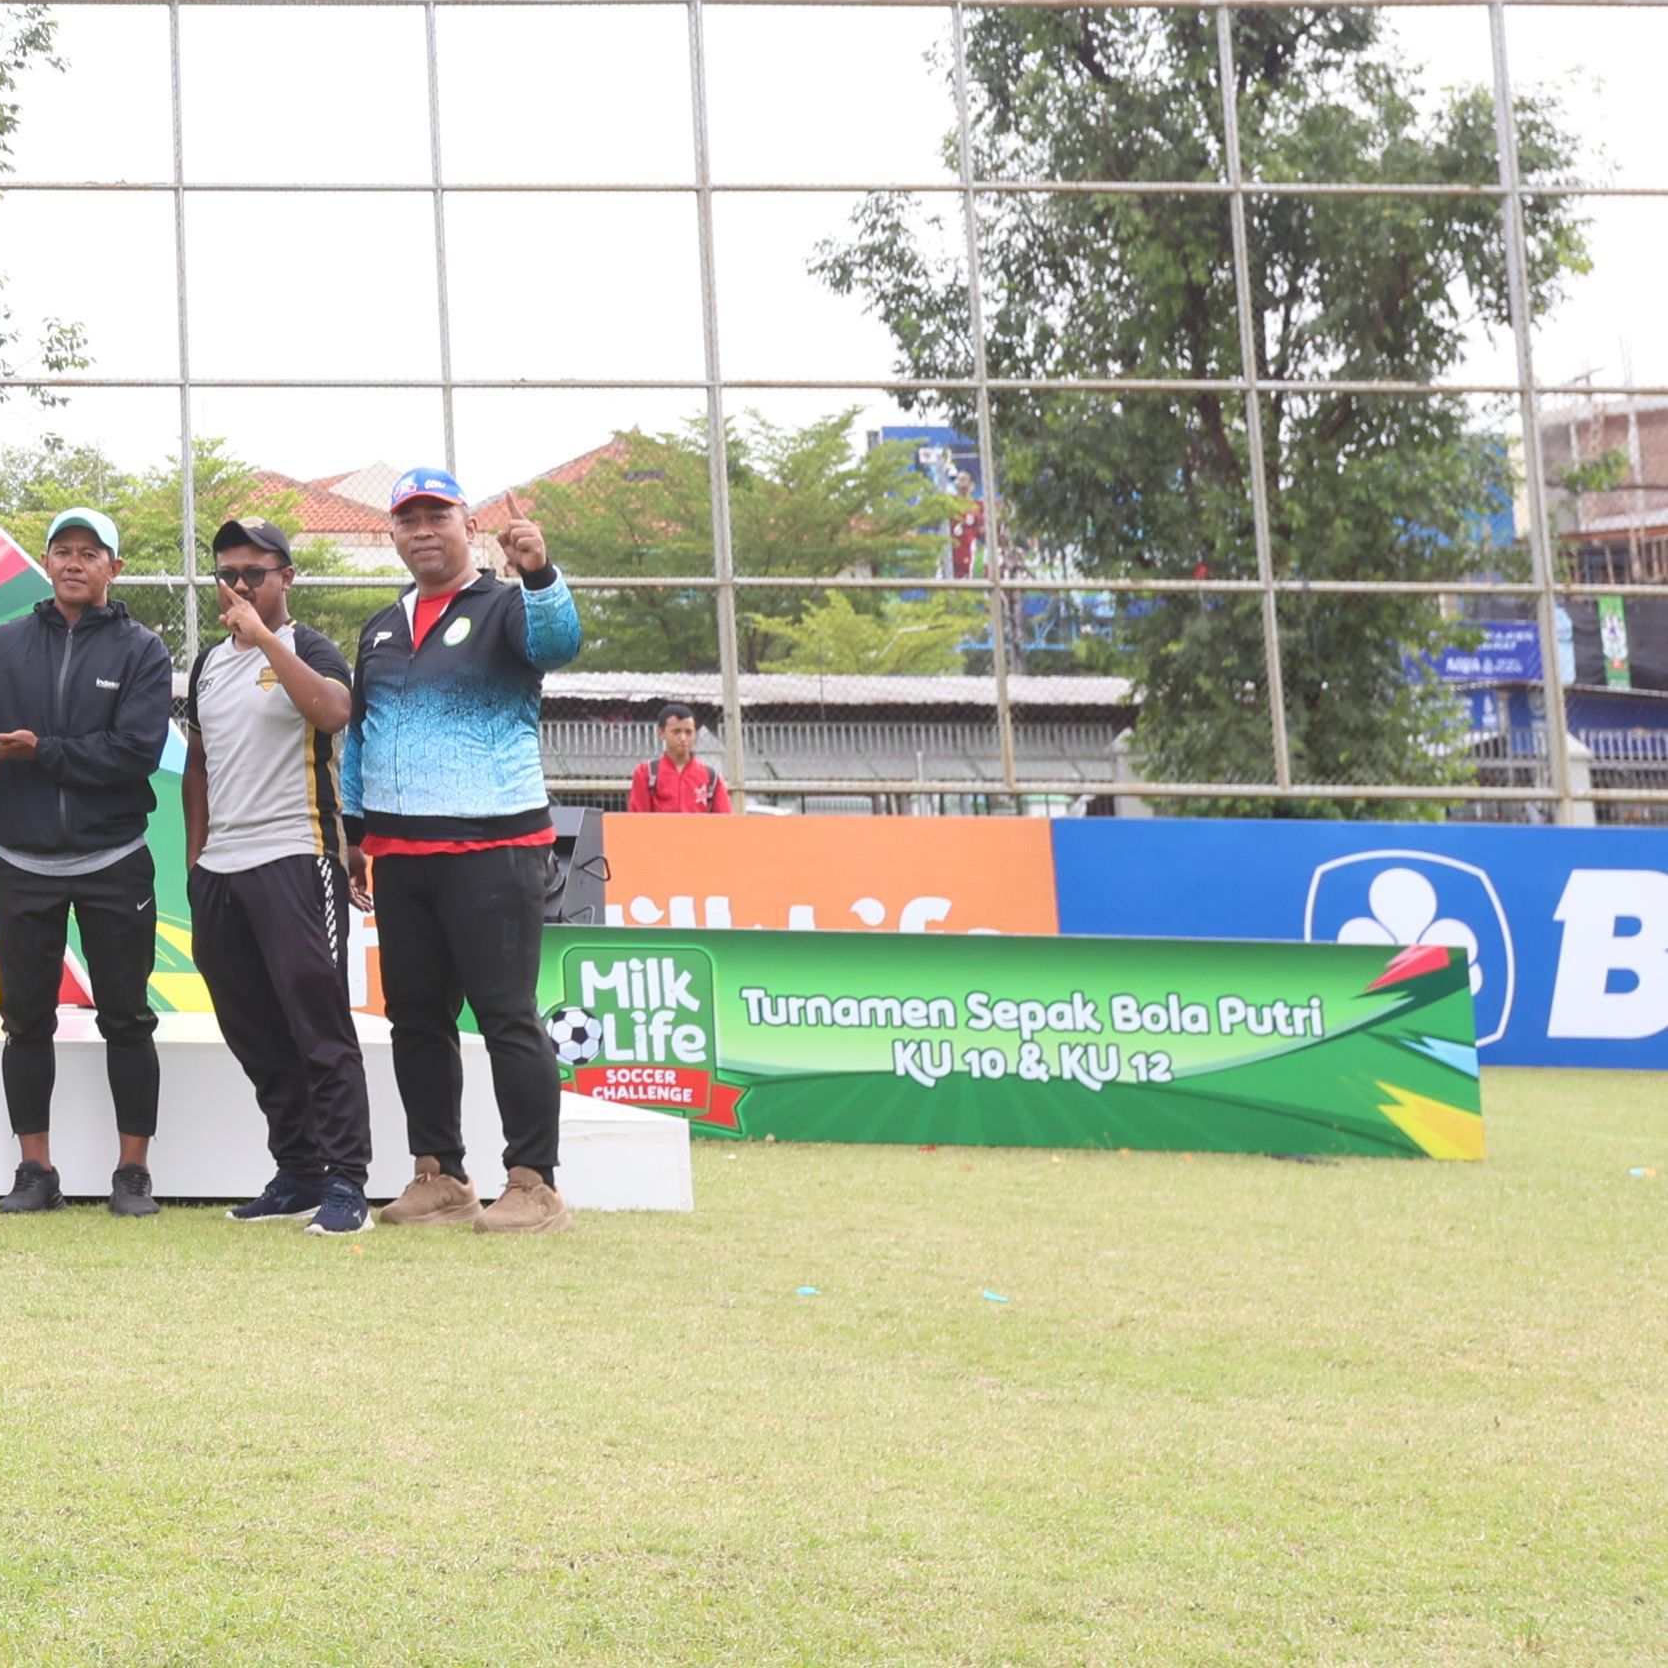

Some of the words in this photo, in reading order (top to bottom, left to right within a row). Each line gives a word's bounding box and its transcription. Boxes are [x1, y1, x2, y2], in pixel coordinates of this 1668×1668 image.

[581, 957, 701, 1013] Milk
[603, 1010, 707, 1063] Life
[740, 988, 957, 1029] Turnamen
[966, 992, 1103, 1042] Sepak
[1111, 994, 1211, 1037] Bola
[1219, 997, 1325, 1038] Putri
[606, 1069, 676, 1085] SOCCER
[894, 1039, 954, 1087] KU
[963, 1047, 1006, 1080] 10
[1015, 1041, 1050, 1083] &
[1061, 1041, 1122, 1091] KU
[1129, 1051, 1174, 1084] 12
[592, 1085, 693, 1103] CHALLENGE
